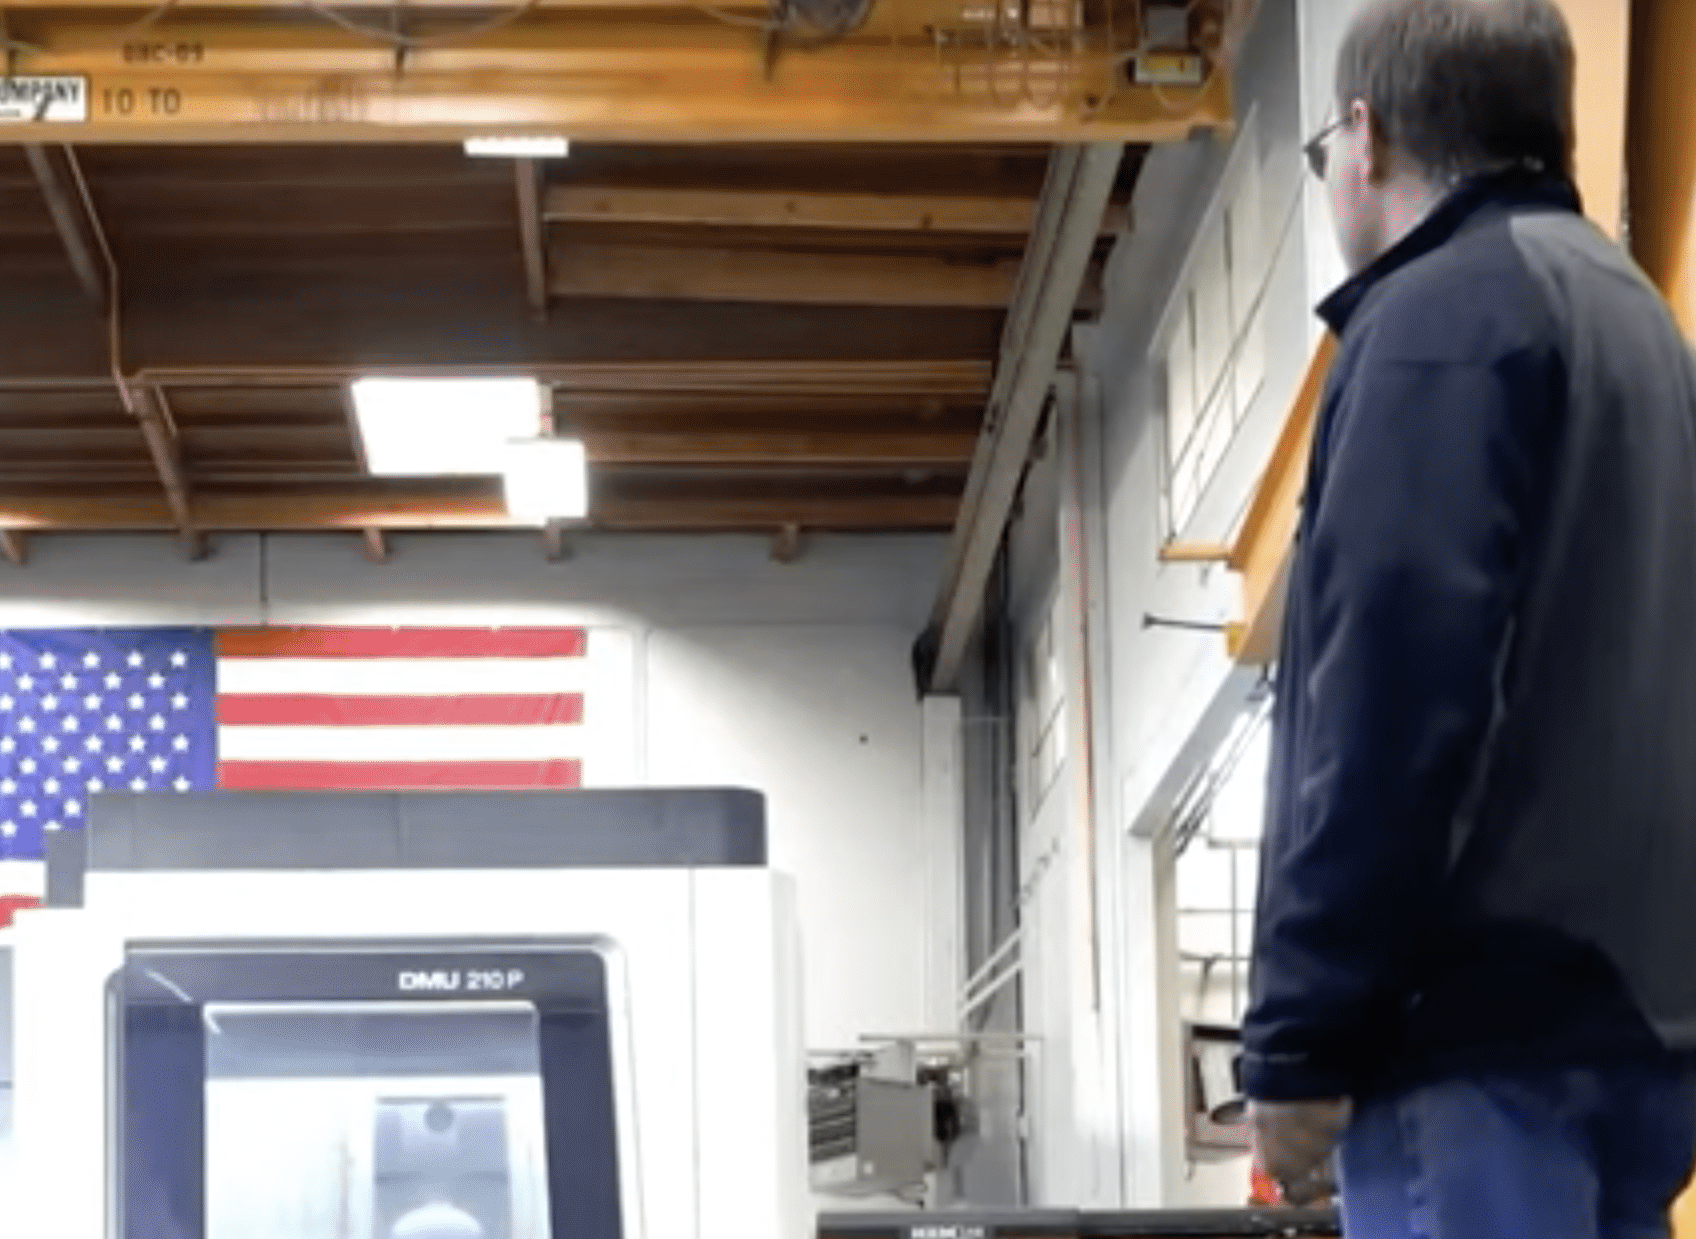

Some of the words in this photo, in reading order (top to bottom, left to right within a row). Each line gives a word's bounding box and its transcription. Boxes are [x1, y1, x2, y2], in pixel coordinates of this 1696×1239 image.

[103, 88, 135, 115] 10
[399, 971, 460, 990] DMU
[466, 970, 504, 990] 210
[507, 969, 525, 989] P
